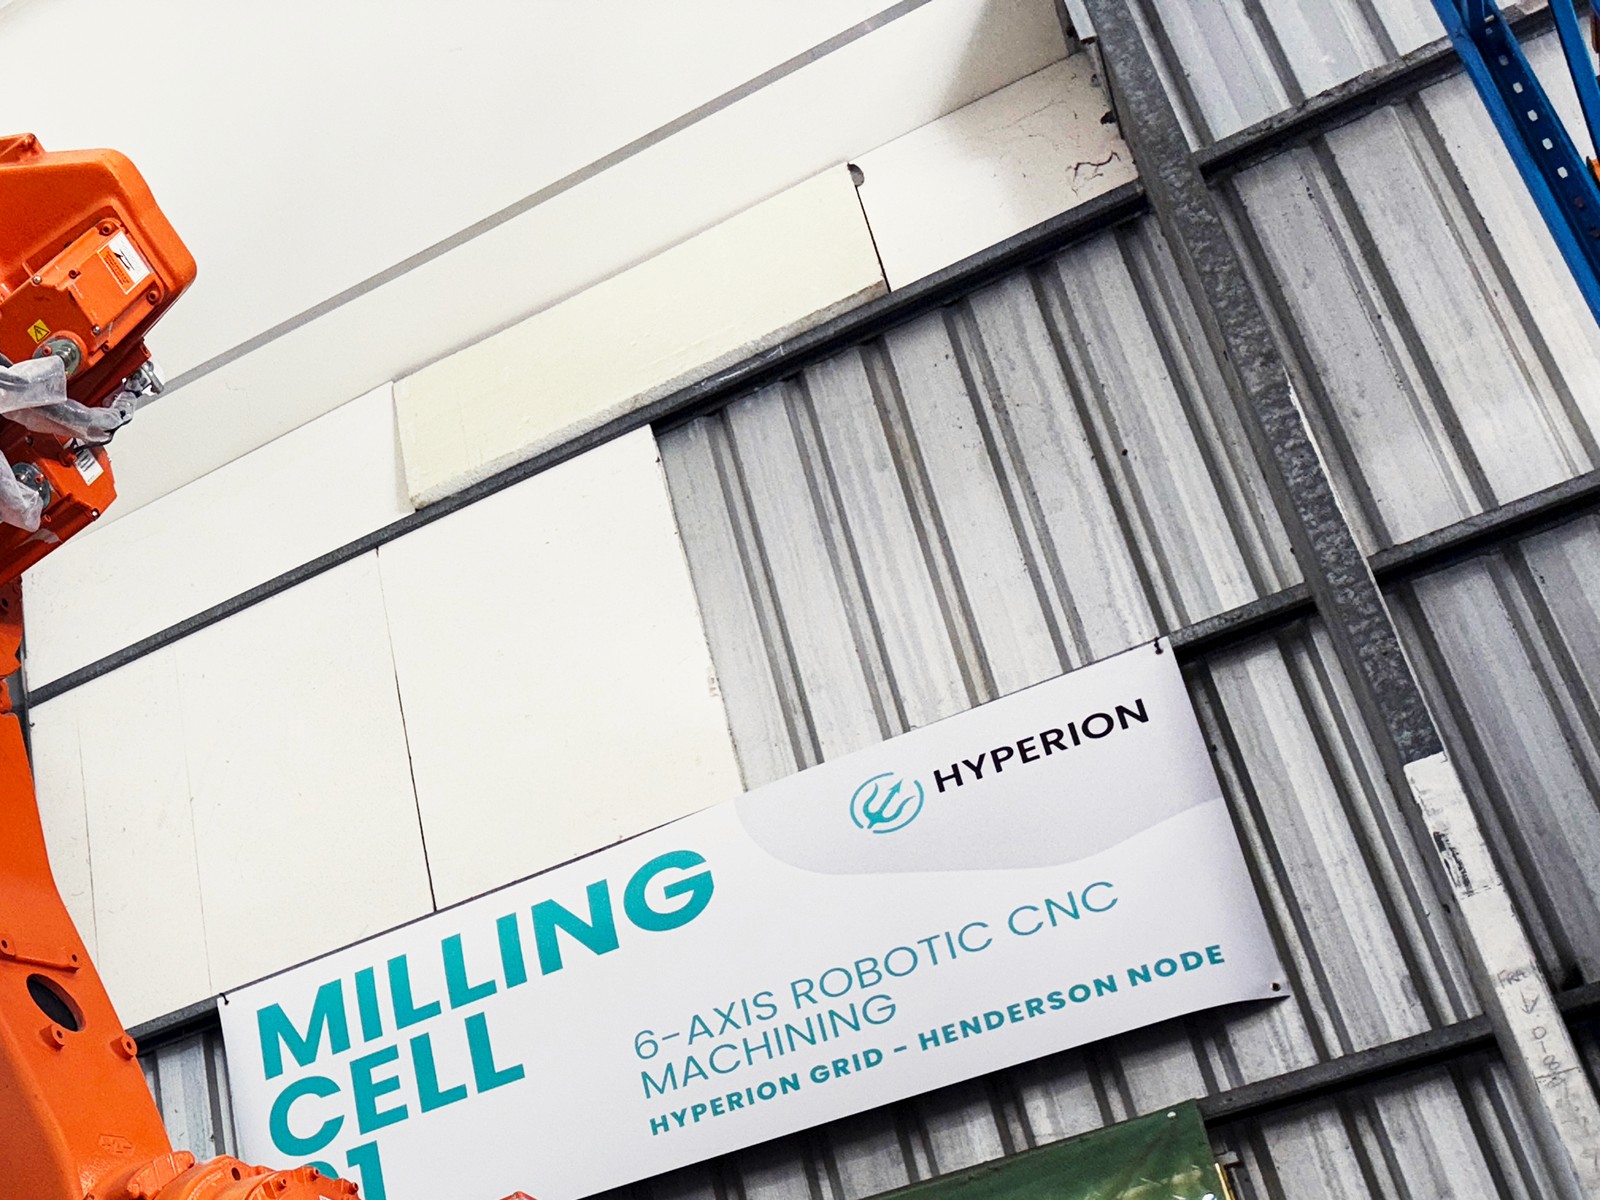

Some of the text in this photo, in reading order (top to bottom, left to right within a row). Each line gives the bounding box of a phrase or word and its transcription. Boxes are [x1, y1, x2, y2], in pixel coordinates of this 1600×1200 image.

[933, 698, 1149, 793] HYPERION
[257, 850, 714, 1080] MILLING
[634, 881, 1118, 1060] 6-AXIS ROBOTIC CNC
[649, 1058, 801, 1136] HYPERION
[809, 1048, 884, 1085] GRID
[918, 975, 1118, 1052] HENDERSON
[1127, 944, 1225, 987] NODE
[269, 1012, 525, 1157] CELL
[640, 994, 897, 1100] MACHINING
